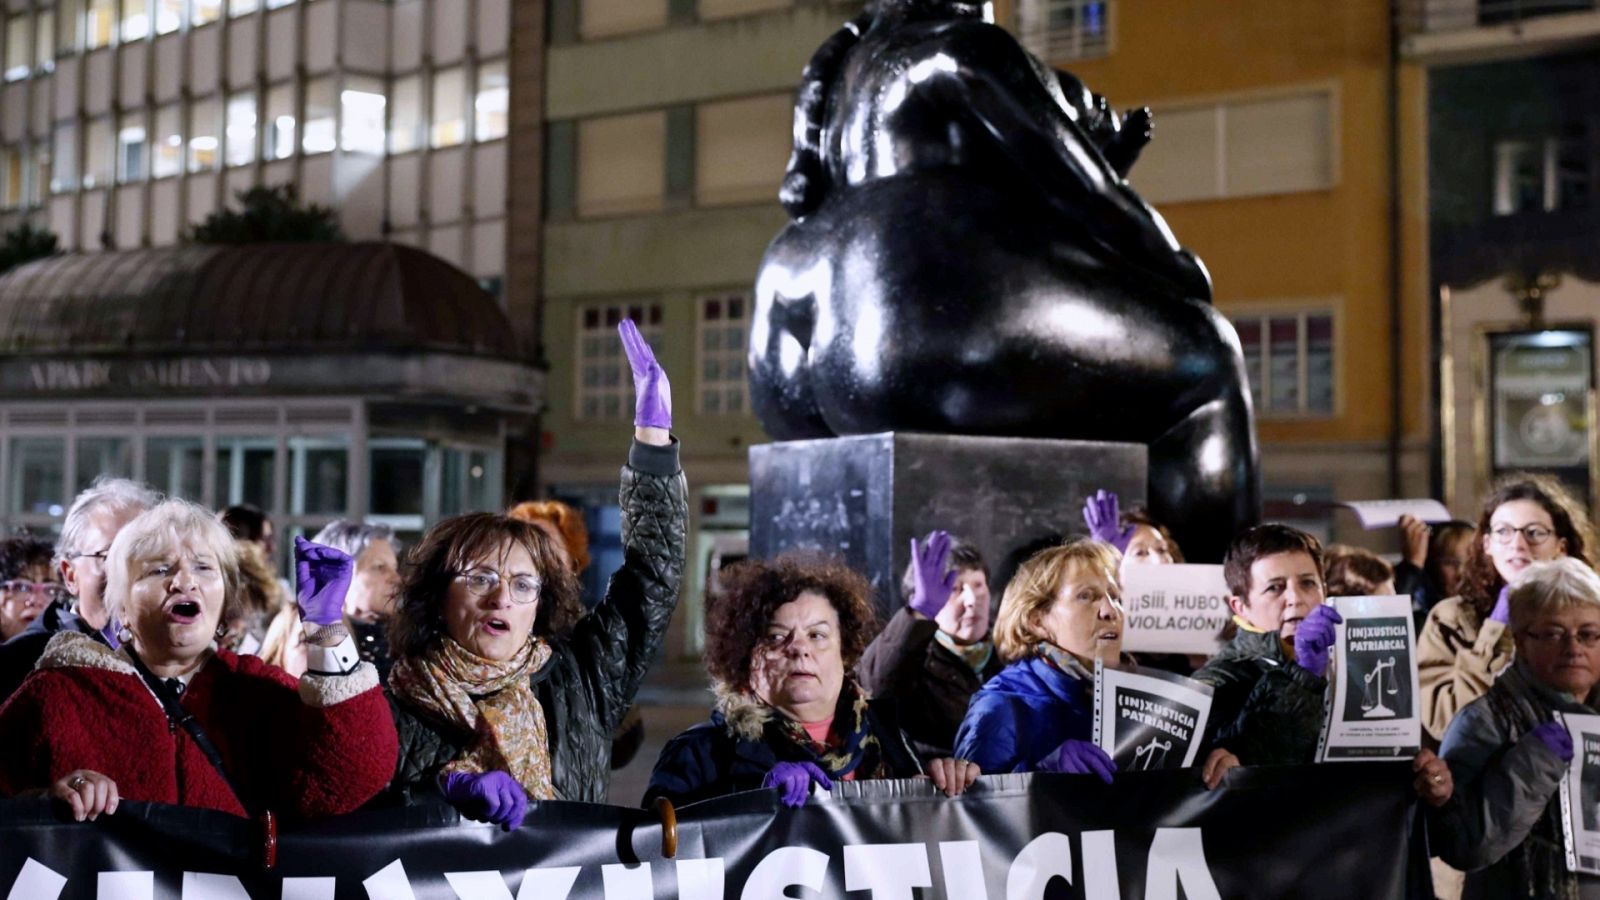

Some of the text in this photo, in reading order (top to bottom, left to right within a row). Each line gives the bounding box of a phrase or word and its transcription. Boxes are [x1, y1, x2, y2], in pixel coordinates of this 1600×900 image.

[1174, 595, 1220, 610] HUBO
[1347, 625, 1407, 640] (IN)XUSTICIA
[1350, 640, 1406, 652] PATRIARCAL
[1118, 694, 1195, 729] (IN)XUSTICIA
[1121, 708, 1188, 741] PATRIARCAL
